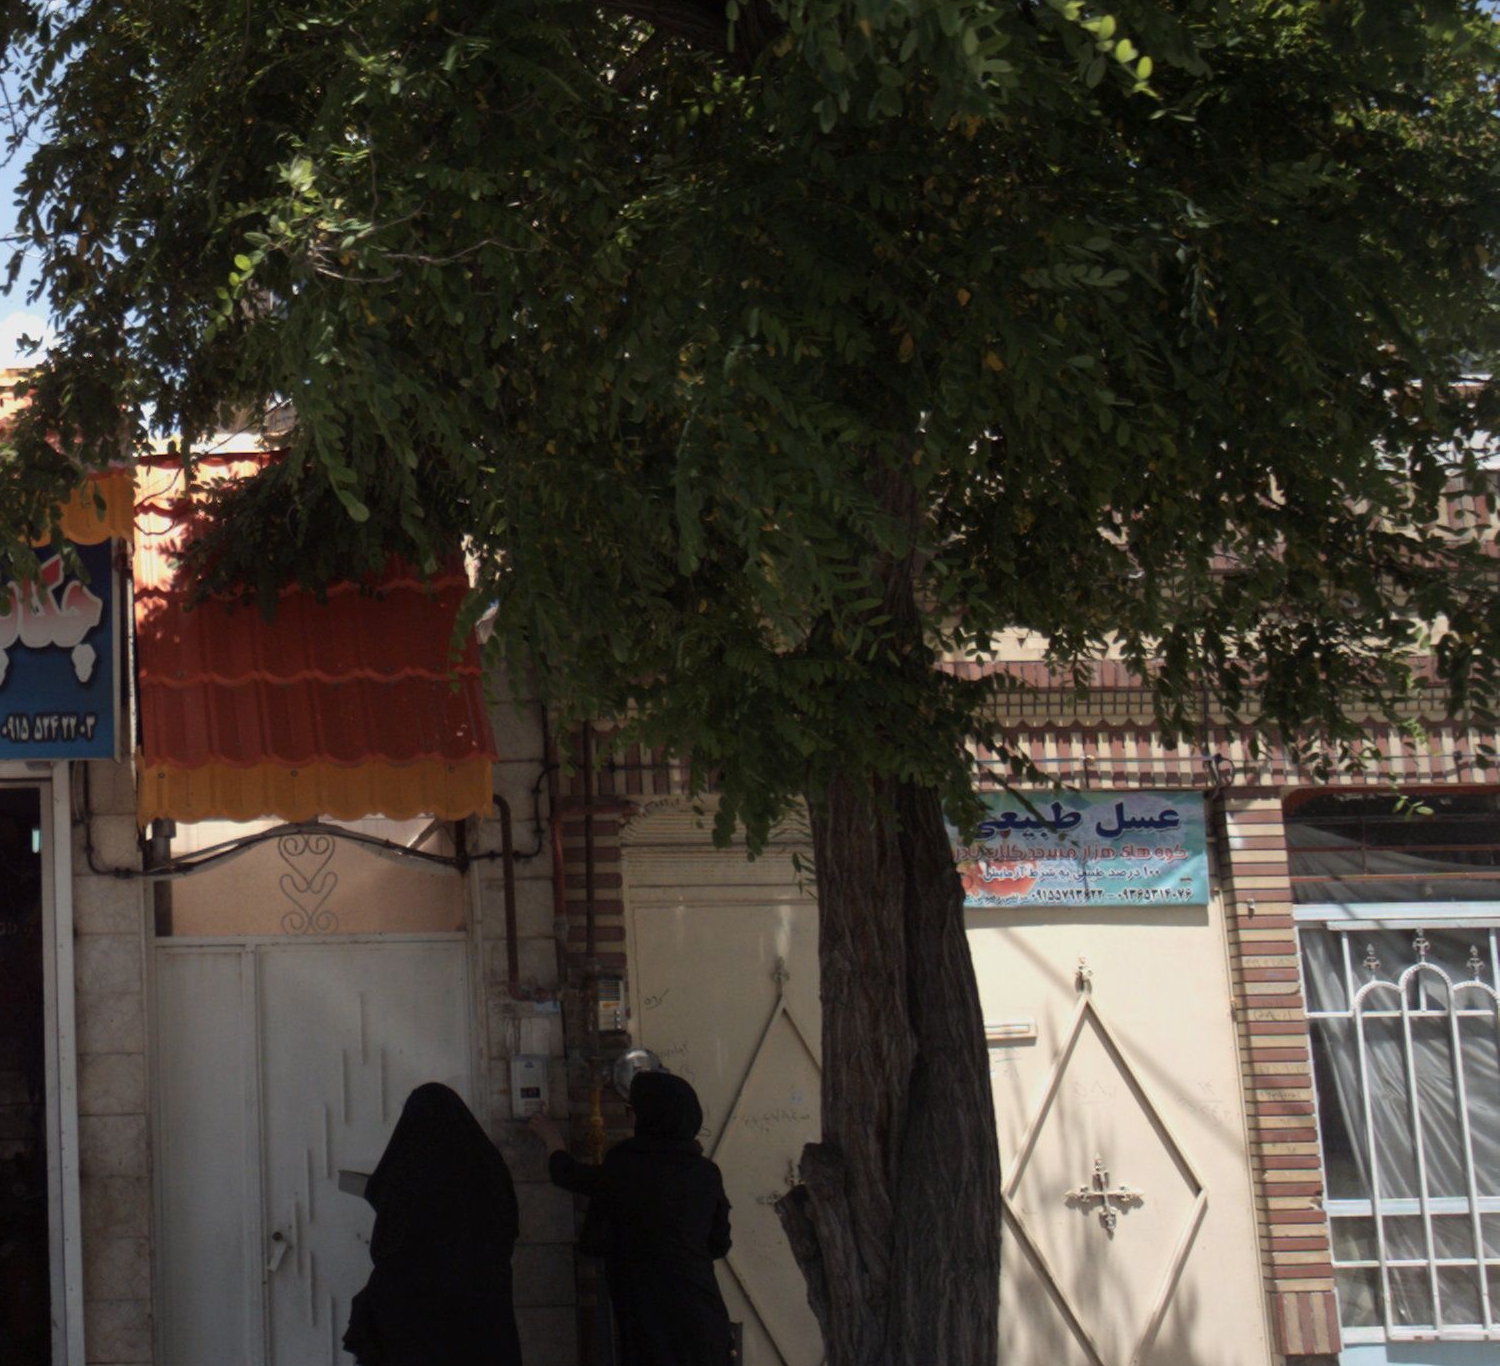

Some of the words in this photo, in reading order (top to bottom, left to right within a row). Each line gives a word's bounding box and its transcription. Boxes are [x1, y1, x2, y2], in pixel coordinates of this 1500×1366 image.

[975, 800, 1082, 841] طبیعی
[1095, 801, 1181, 839] عسل
[1026, 845, 1077, 860] مسجد
[1079, 844, 1116, 862] هزار
[1119, 844, 1151, 859] های
[1155, 843, 1189, 863] کوه
[1029, 866, 1056, 880] شرط
[1058, 869, 1070, 879] به
[1107, 869, 1141, 881] درصد
